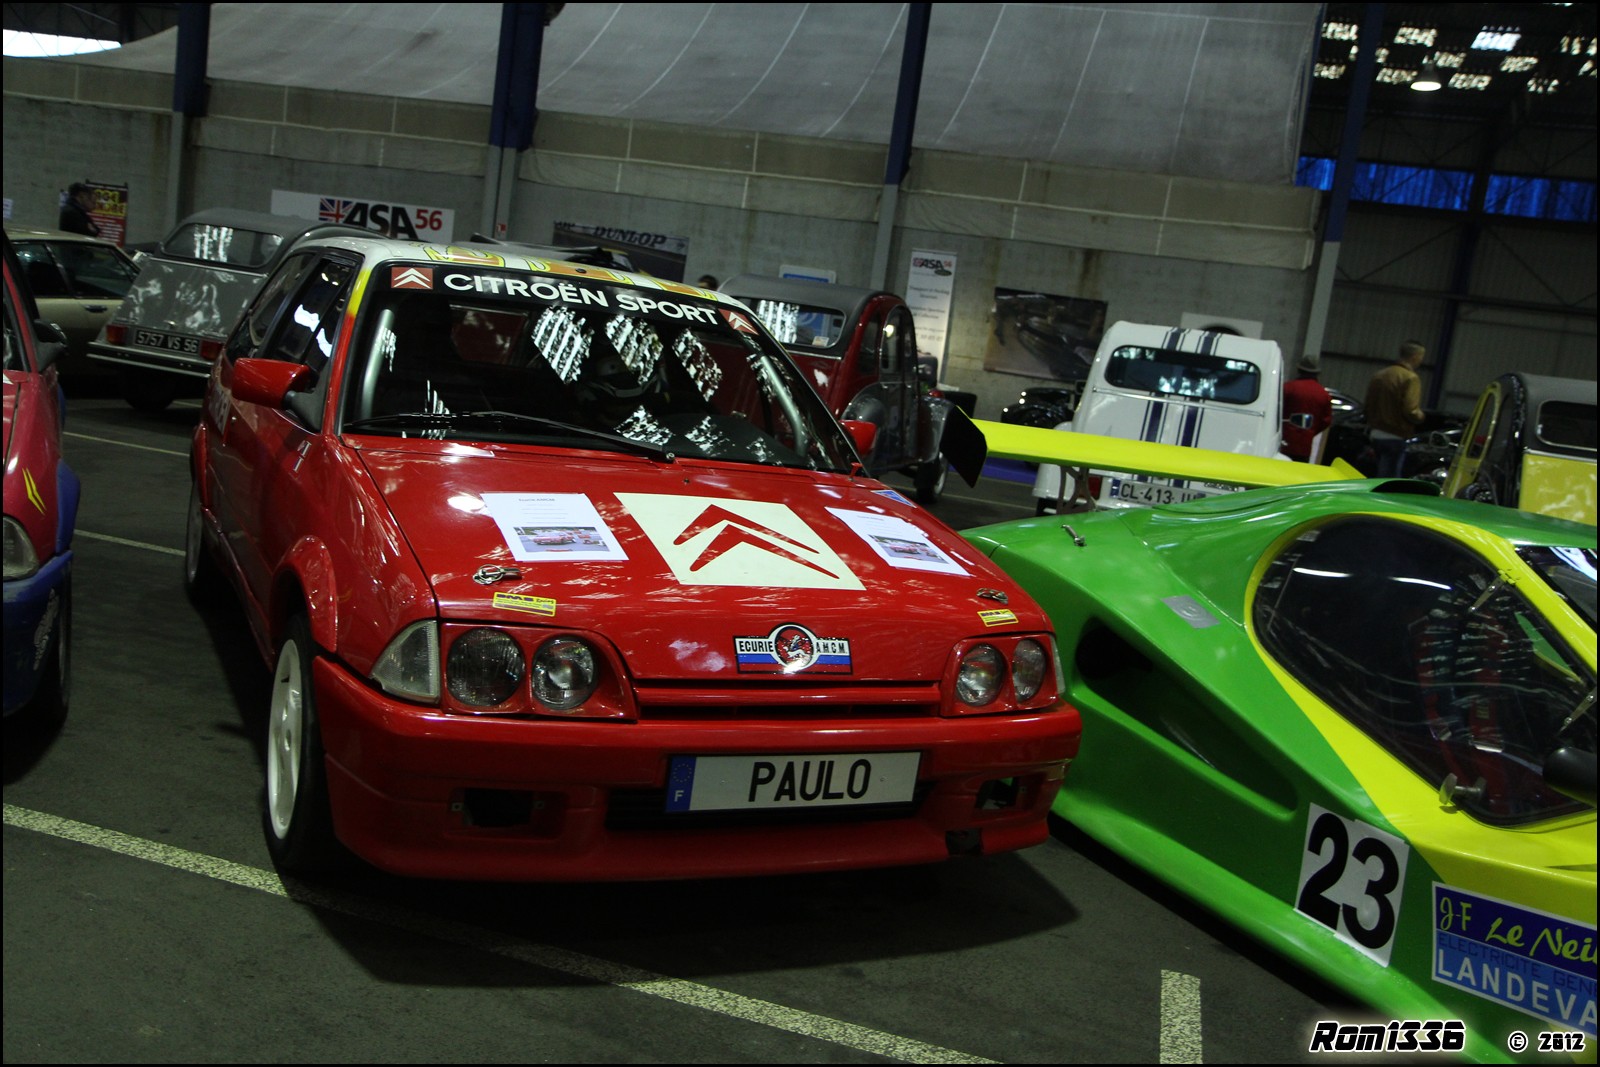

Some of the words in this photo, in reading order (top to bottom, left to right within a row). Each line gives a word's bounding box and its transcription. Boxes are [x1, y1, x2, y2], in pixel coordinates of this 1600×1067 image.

[343, 202, 418, 239] ASA
[415, 208, 442, 230] 56
[592, 226, 667, 247] DUNLOP
[443, 273, 610, 308] CITROËN
[611, 294, 719, 326] SPORT
[183, 338, 199, 353] 56
[738, 640, 774, 652] ECURIE
[674, 790, 685, 803] F
[748, 758, 872, 803] PAULO
[1298, 813, 1399, 950] 23
[1485, 917, 1526, 947] Le
[1438, 933, 1542, 979] ELECTRICITE
[1552, 970, 1598, 998] GEN
